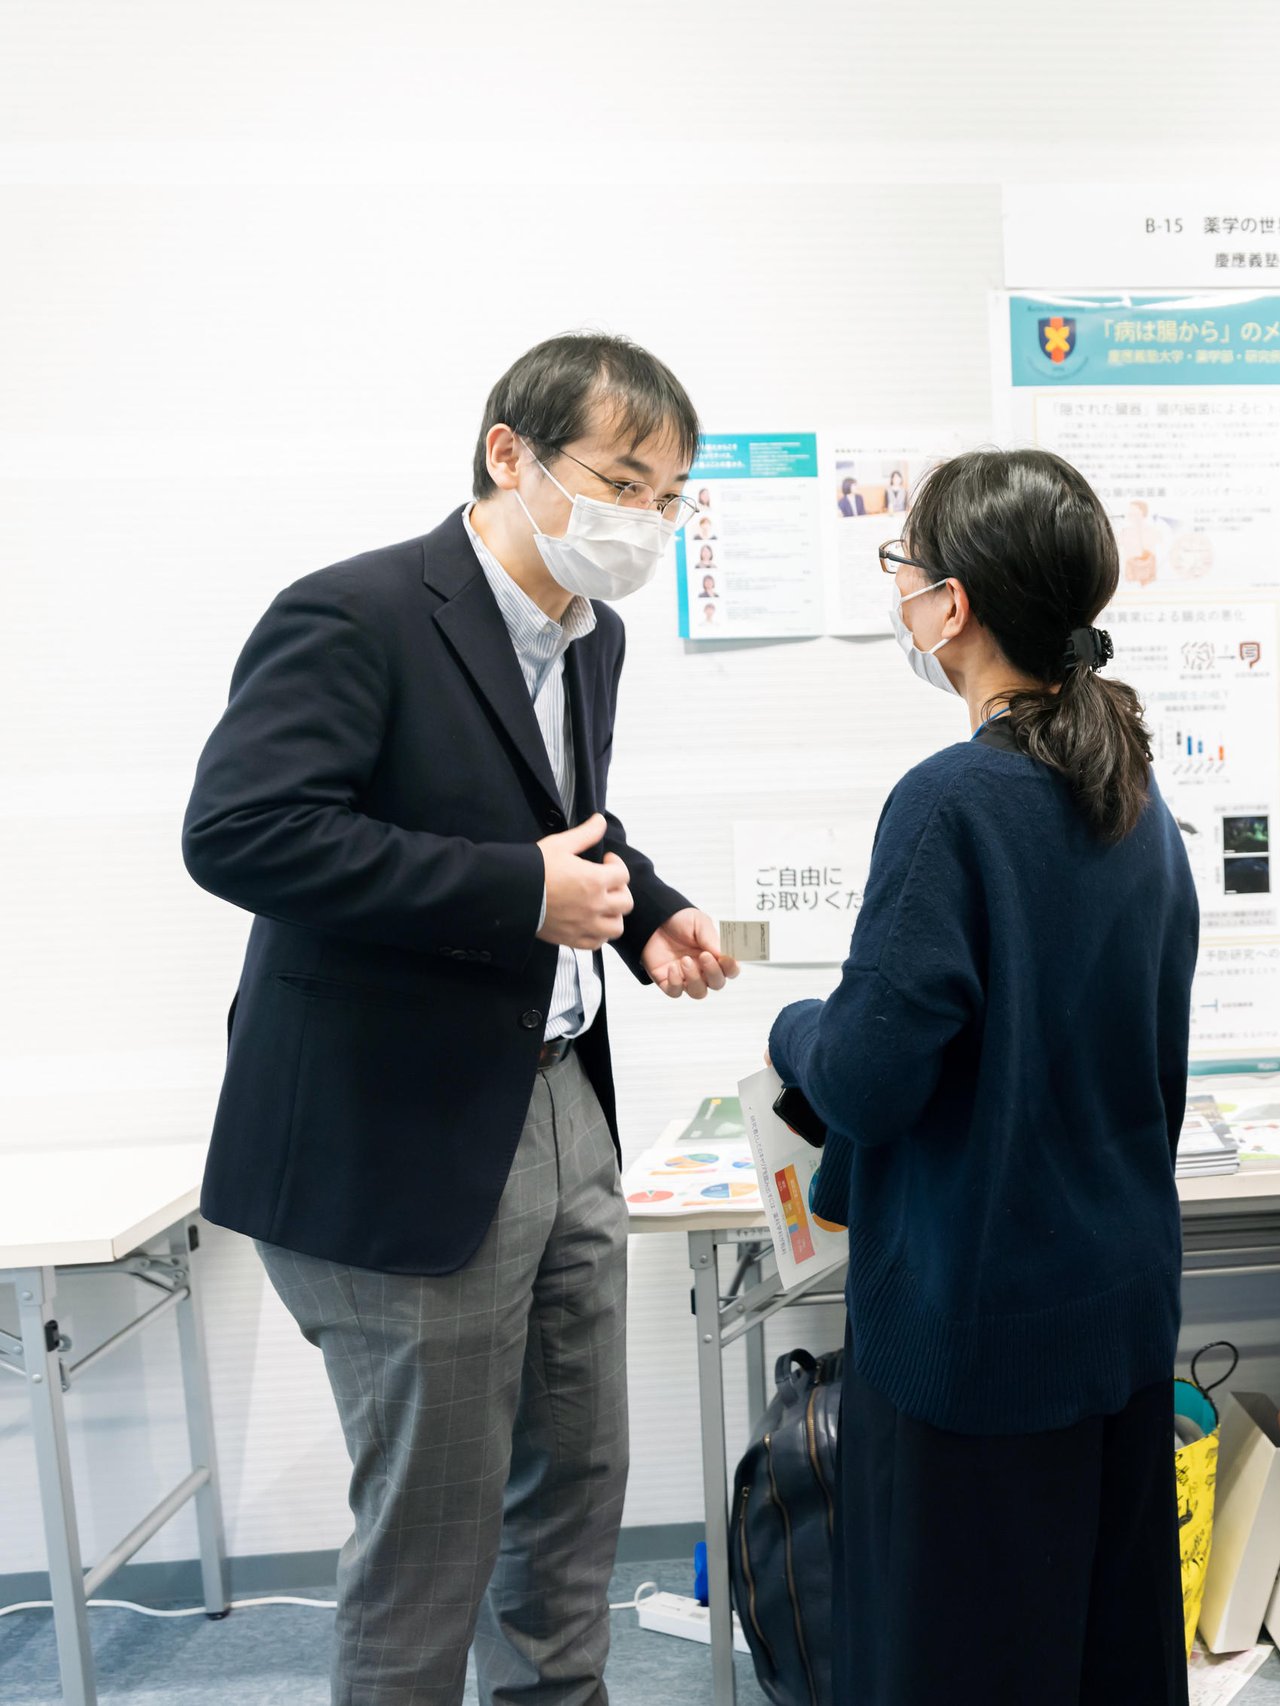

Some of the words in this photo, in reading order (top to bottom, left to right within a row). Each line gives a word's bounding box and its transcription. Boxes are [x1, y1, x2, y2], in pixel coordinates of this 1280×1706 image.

[1145, 217, 1184, 234] B-15
[756, 866, 843, 887] ご自由に
[756, 889, 864, 912] お取りくだ
